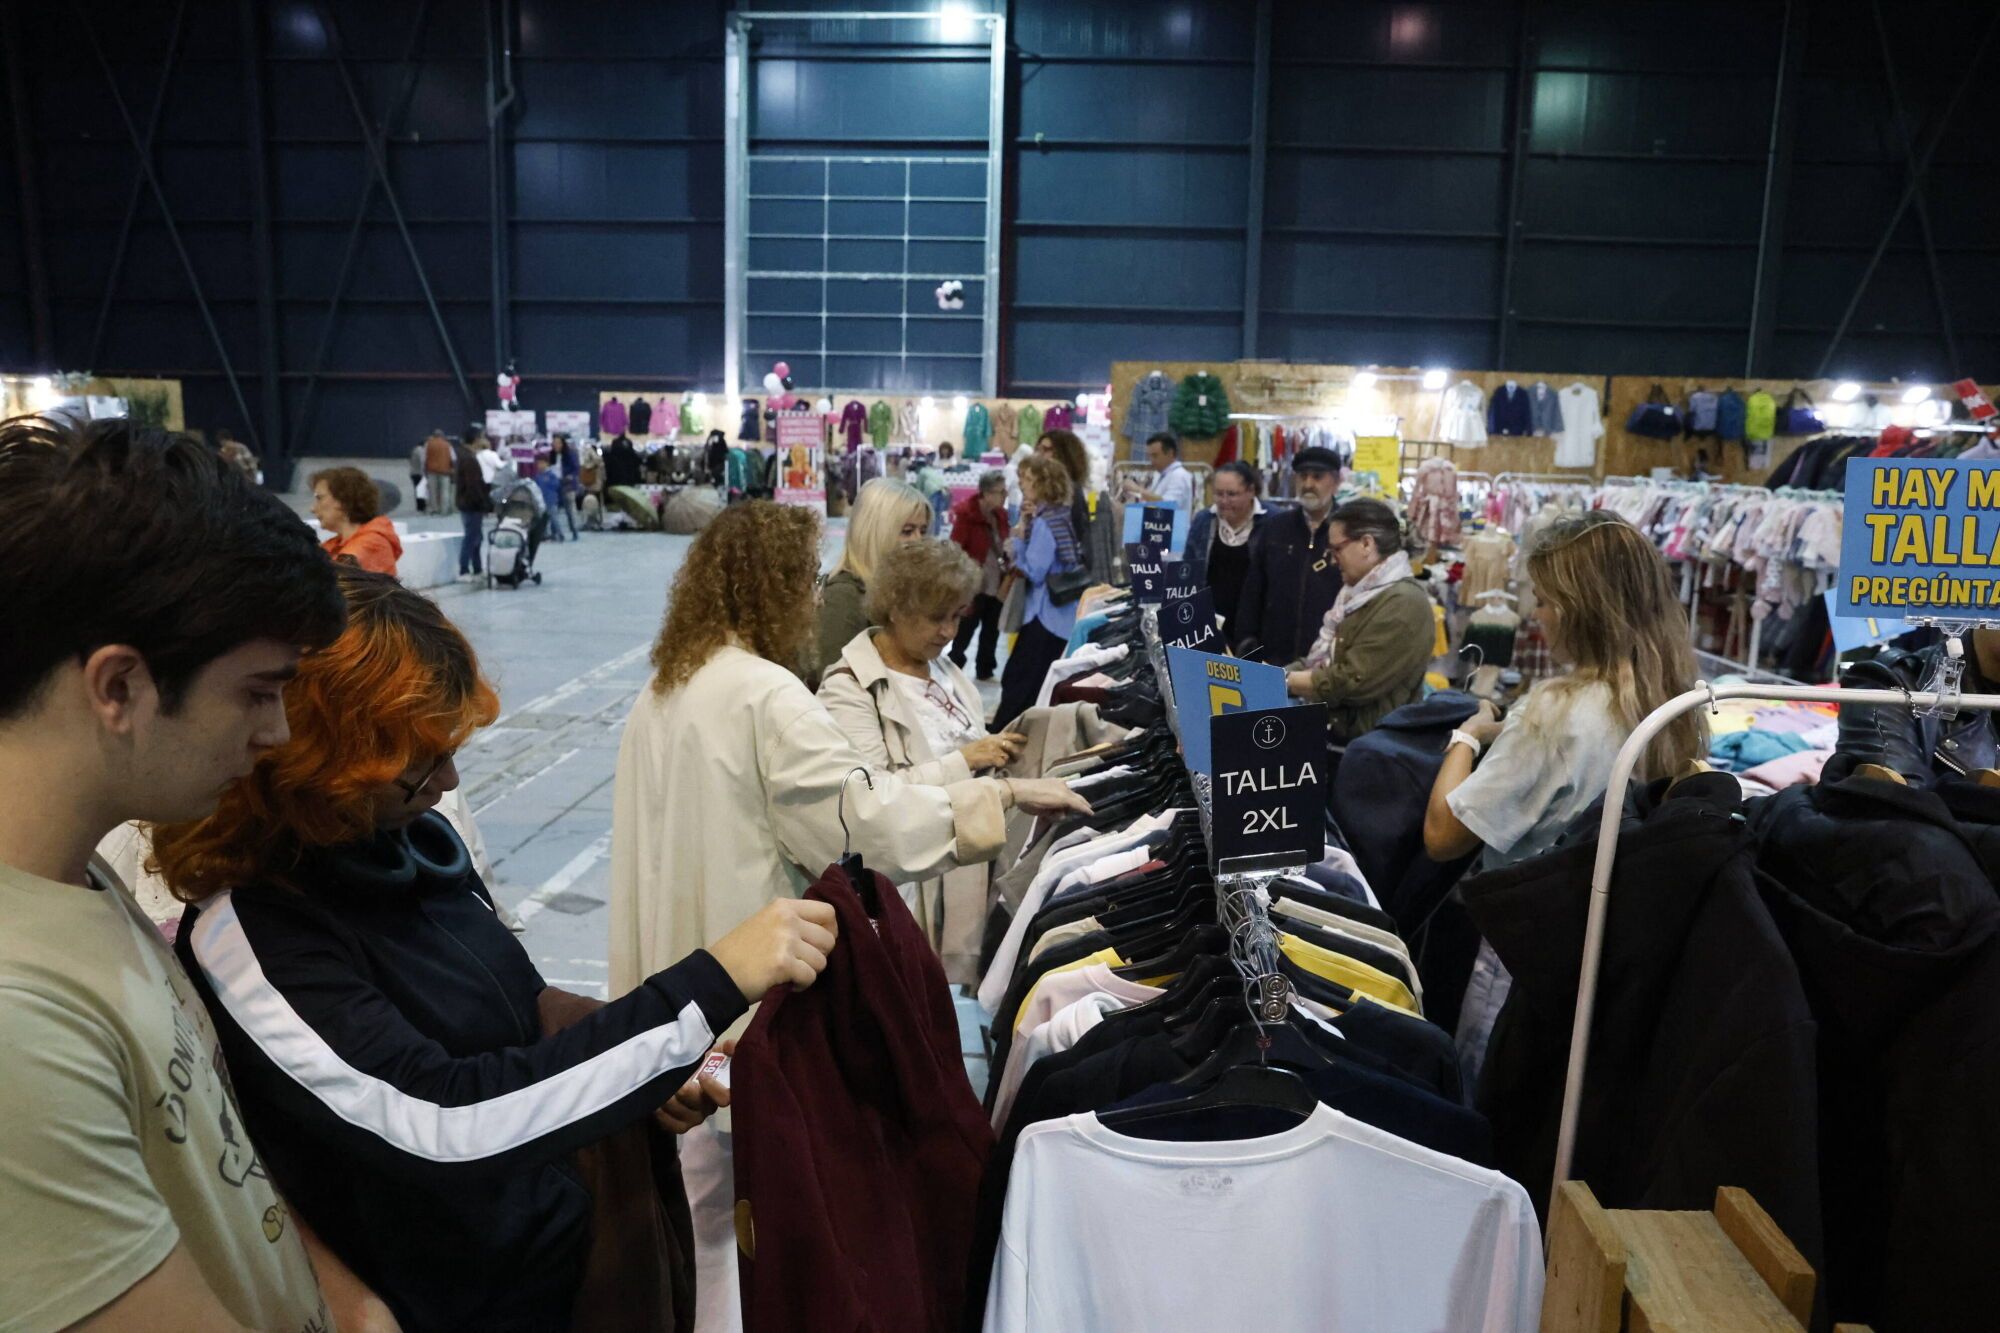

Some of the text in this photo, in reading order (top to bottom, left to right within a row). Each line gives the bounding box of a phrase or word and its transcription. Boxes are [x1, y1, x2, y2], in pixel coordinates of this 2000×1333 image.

[1872, 467, 1958, 508] HAY
[1144, 521, 1171, 532] TALLA
[1130, 563, 1162, 575] TALLA
[1144, 579, 1153, 590] S
[1165, 585, 1197, 600] TALLA
[1206, 660, 1241, 683] DESDE
[1219, 761, 1318, 797] TALLA
[1242, 806, 1298, 835] 2XL
